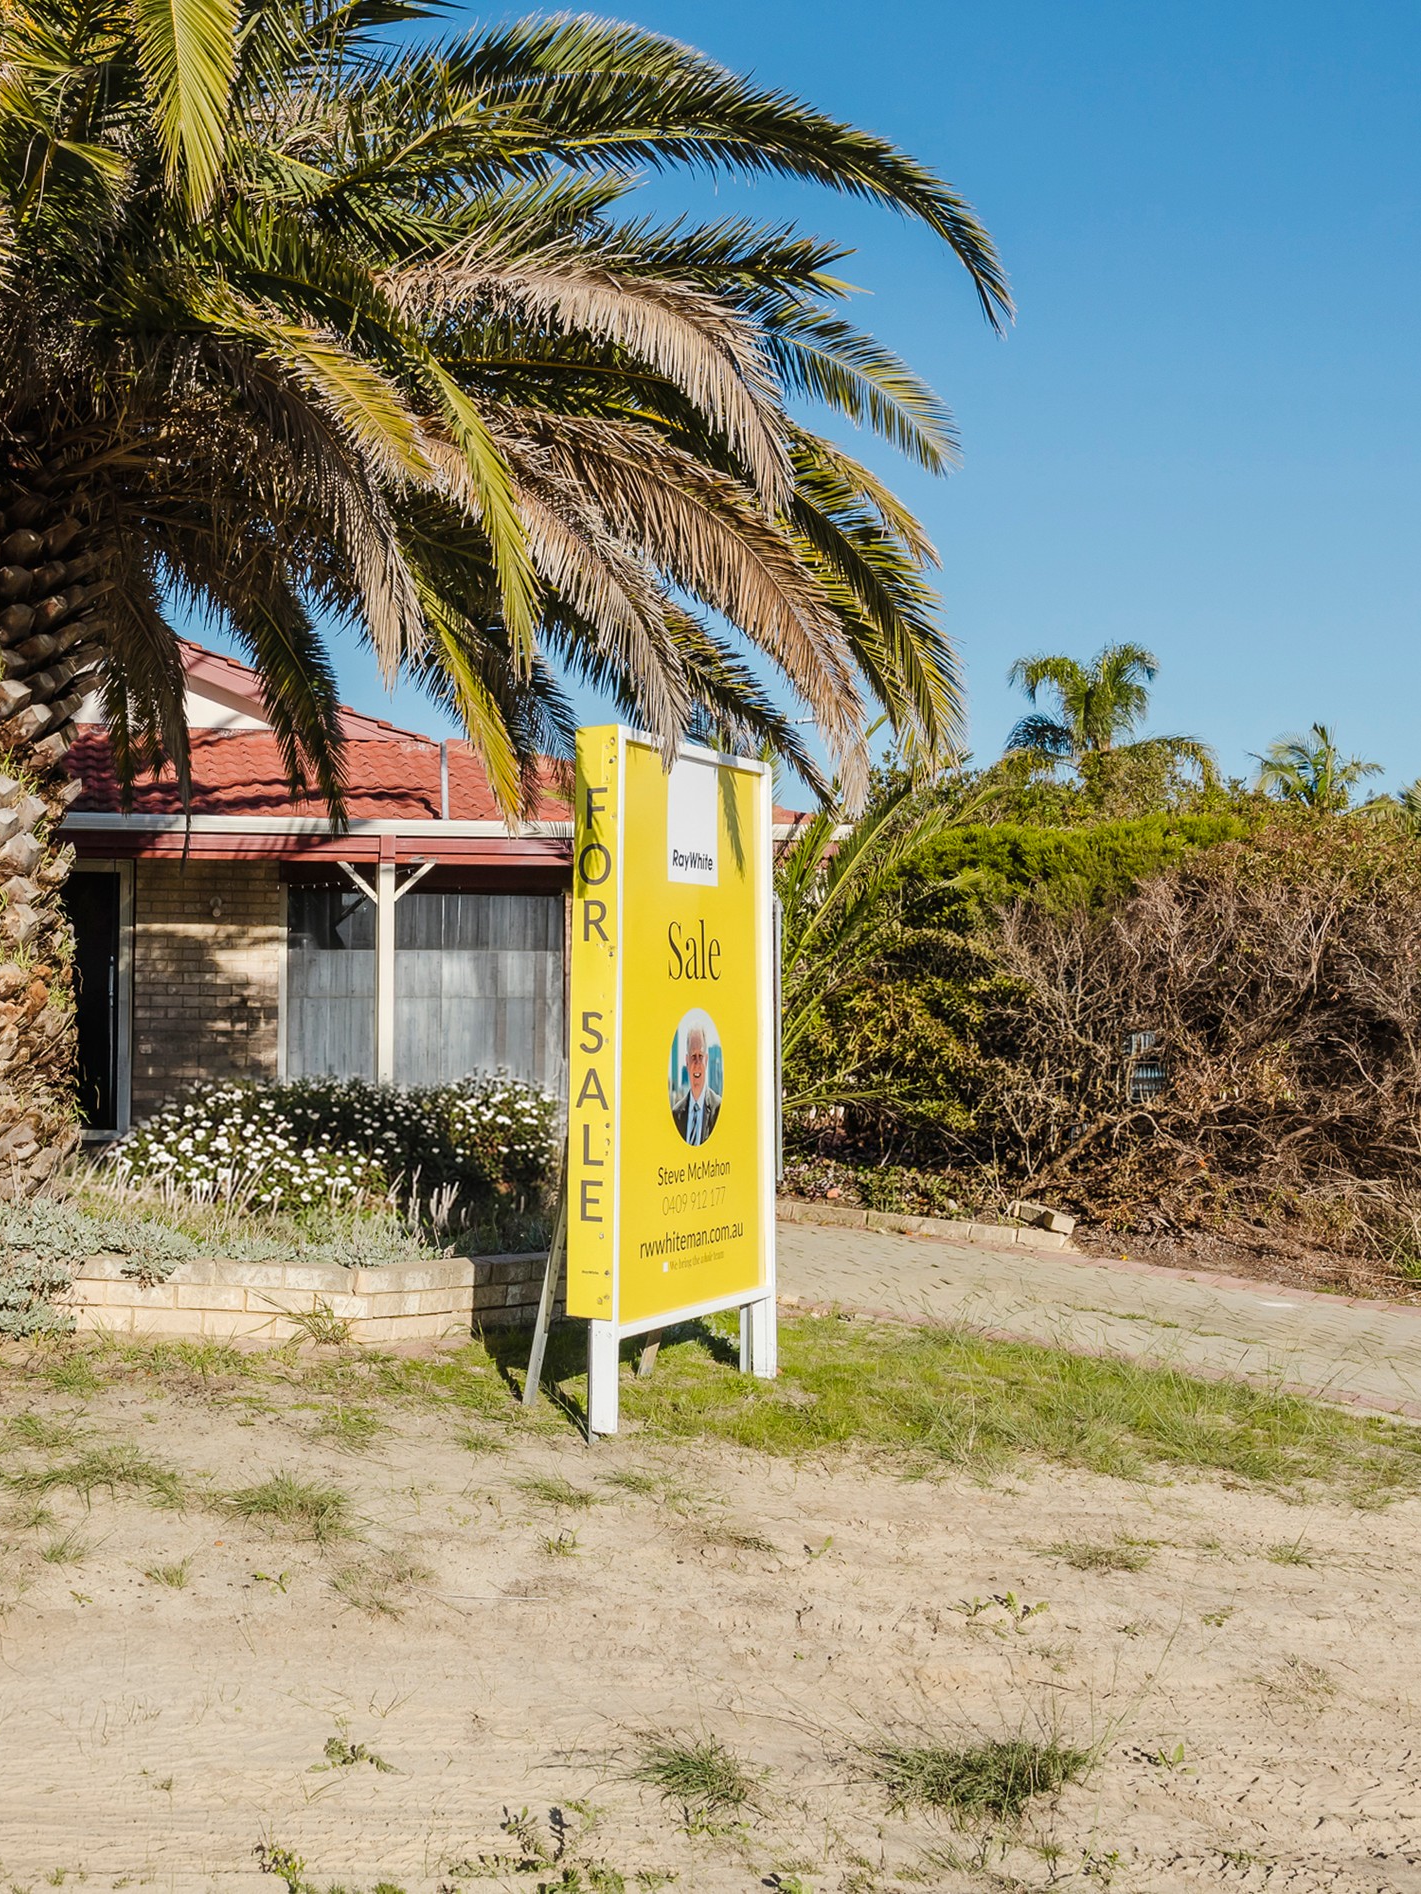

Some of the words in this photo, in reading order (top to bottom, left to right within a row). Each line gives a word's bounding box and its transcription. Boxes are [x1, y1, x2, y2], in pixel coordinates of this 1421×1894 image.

[578, 787, 612, 942] FOR
[672, 849, 713, 871] RayWhite
[668, 919, 721, 981] Sale
[575, 1011, 610, 1223] SALE
[657, 1166, 685, 1186] Steve
[687, 1158, 731, 1181] McMahon
[662, 1193, 687, 1216] 0409
[690, 1189, 707, 1210] 912
[710, 1186, 726, 1207] 177
[640, 1222, 744, 1259] rwwhiteman.com.au
